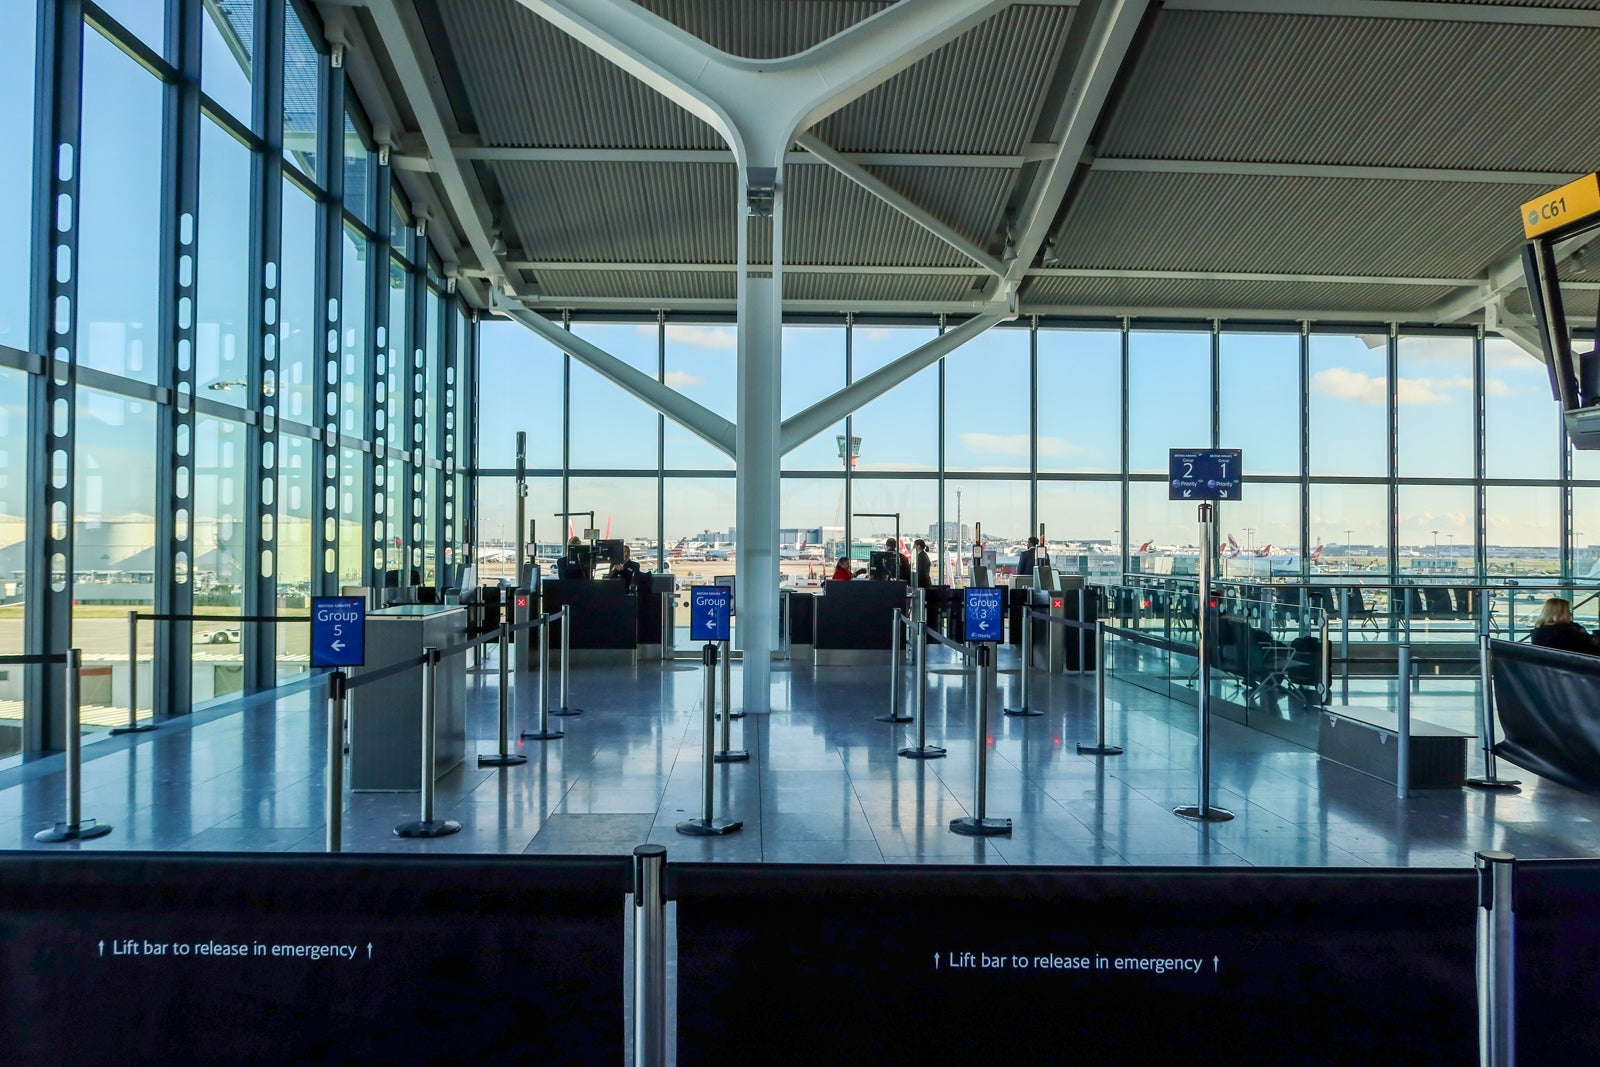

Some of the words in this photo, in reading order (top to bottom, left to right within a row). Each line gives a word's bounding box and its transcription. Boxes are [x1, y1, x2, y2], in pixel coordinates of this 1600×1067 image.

[1541, 197, 1566, 219] C61
[1183, 462, 1193, 478] 2
[1220, 462, 1226, 478] 1
[696, 596, 726, 608] Group
[970, 598, 998, 609] Group
[317, 609, 359, 623] Group
[707, 608, 715, 618] 4
[980, 609, 987, 619] 3
[333, 624, 342, 636] 5
[113, 940, 139, 955] Lift
[143, 940, 168, 955] bar
[173, 942, 190, 955] to
[194, 940, 248, 956] release
[253, 940, 267, 956] in
[271, 944, 357, 959] emergency
[950, 952, 976, 967] Lift
[981, 952, 1007, 968] bar
[1011, 954, 1029, 968] to
[1033, 953, 1090, 969] release
[1095, 953, 1109, 969] in
[1114, 956, 1202, 973] emergency
